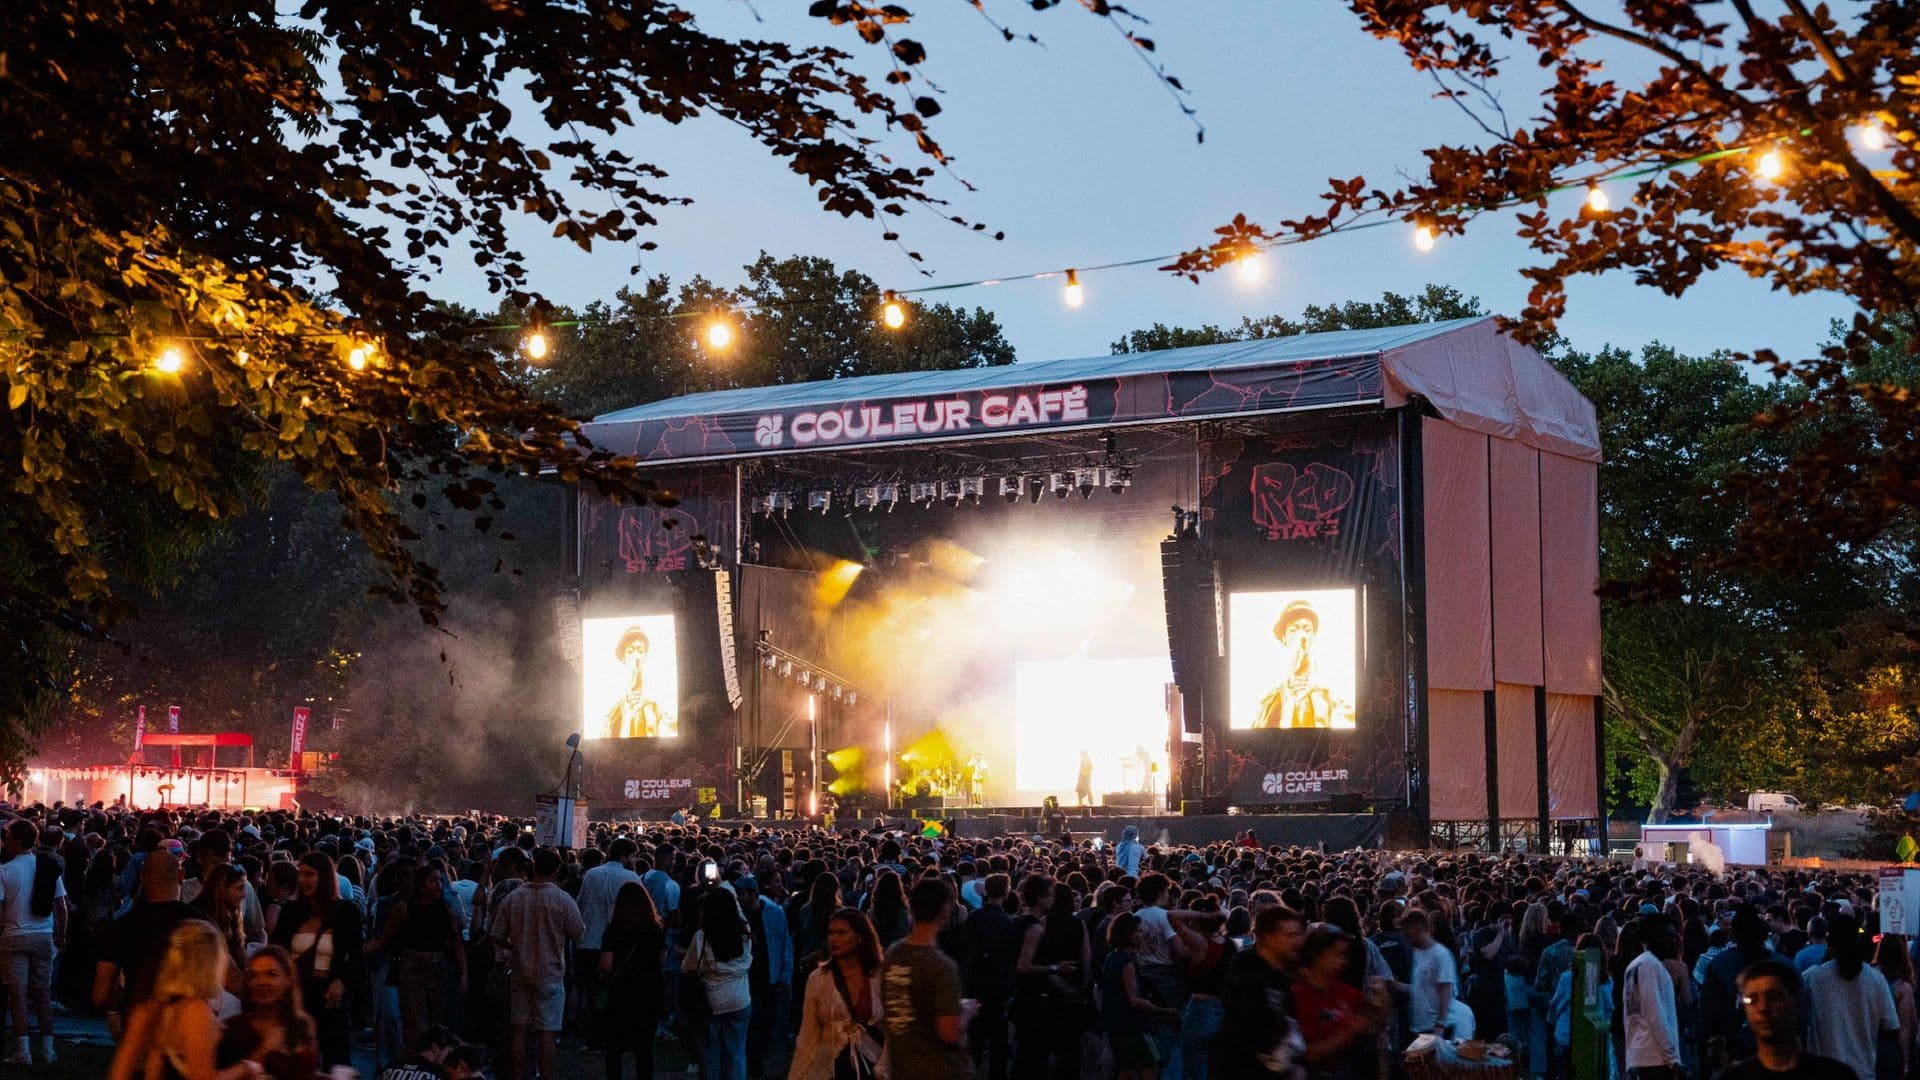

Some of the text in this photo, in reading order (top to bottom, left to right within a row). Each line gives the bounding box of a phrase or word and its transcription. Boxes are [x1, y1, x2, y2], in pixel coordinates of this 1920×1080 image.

[792, 385, 1088, 442] COULEUR CAFÉ
[1285, 769, 1349, 780] COULEUR
[641, 779, 692, 788] COULEUR
